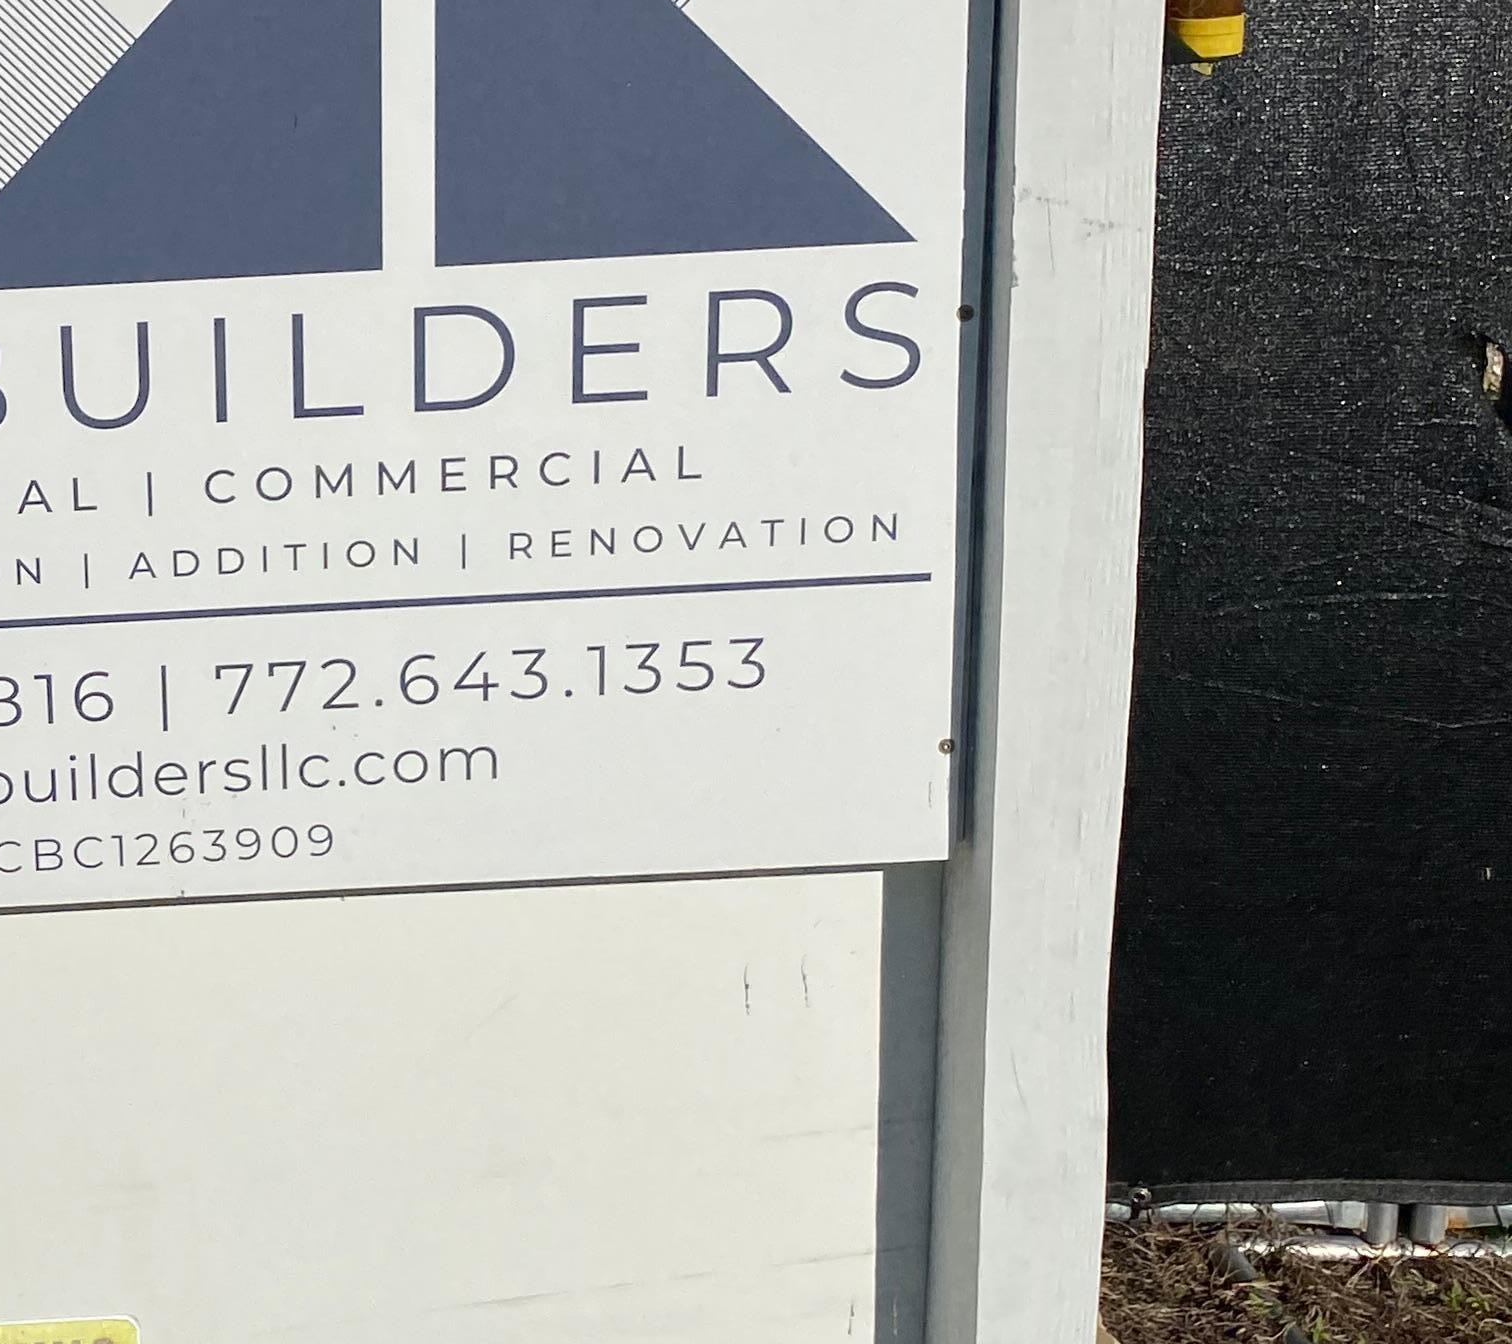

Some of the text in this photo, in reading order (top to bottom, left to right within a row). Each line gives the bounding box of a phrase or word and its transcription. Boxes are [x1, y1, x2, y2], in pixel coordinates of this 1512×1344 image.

[203, 446, 703, 504] COMMERCIAL
[127, 537, 419, 580] ADDITION
[508, 513, 898, 560] RENOVATION
[215, 637, 766, 715] 772.643.1353
